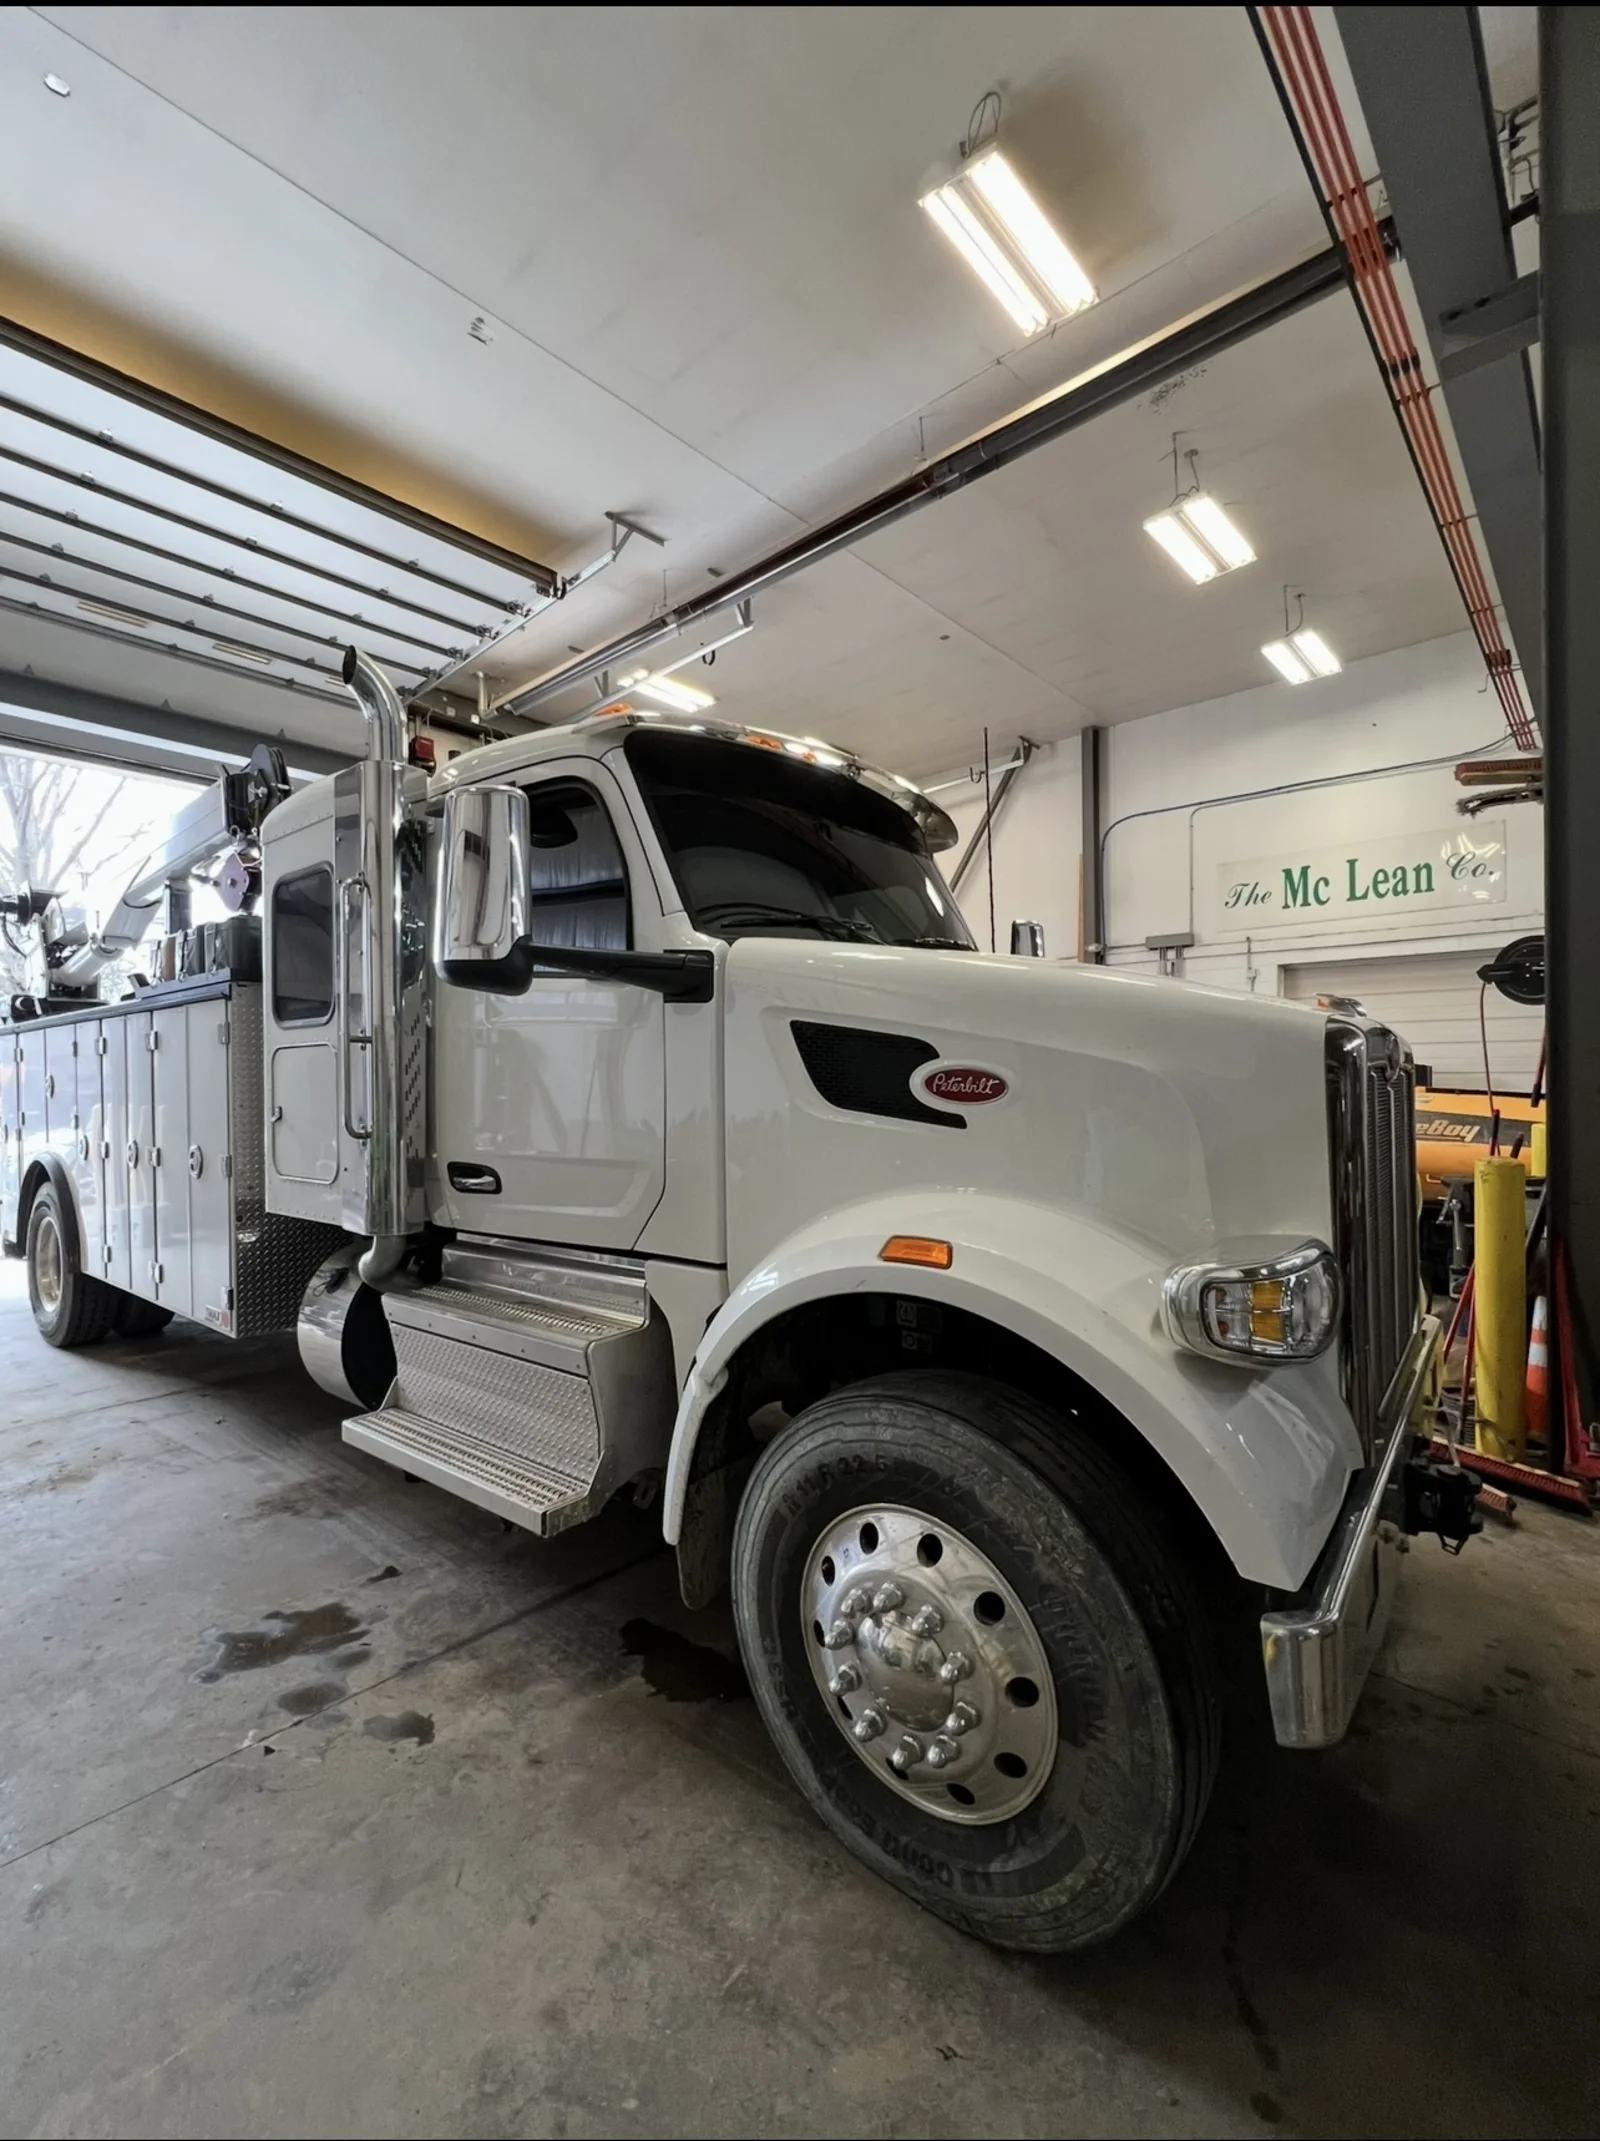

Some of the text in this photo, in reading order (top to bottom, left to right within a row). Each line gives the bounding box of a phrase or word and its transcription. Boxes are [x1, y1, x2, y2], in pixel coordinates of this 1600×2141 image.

[1224, 852, 1495, 909] The Mc Lean Co.
[932, 1073, 1000, 1094] Peterbilt
